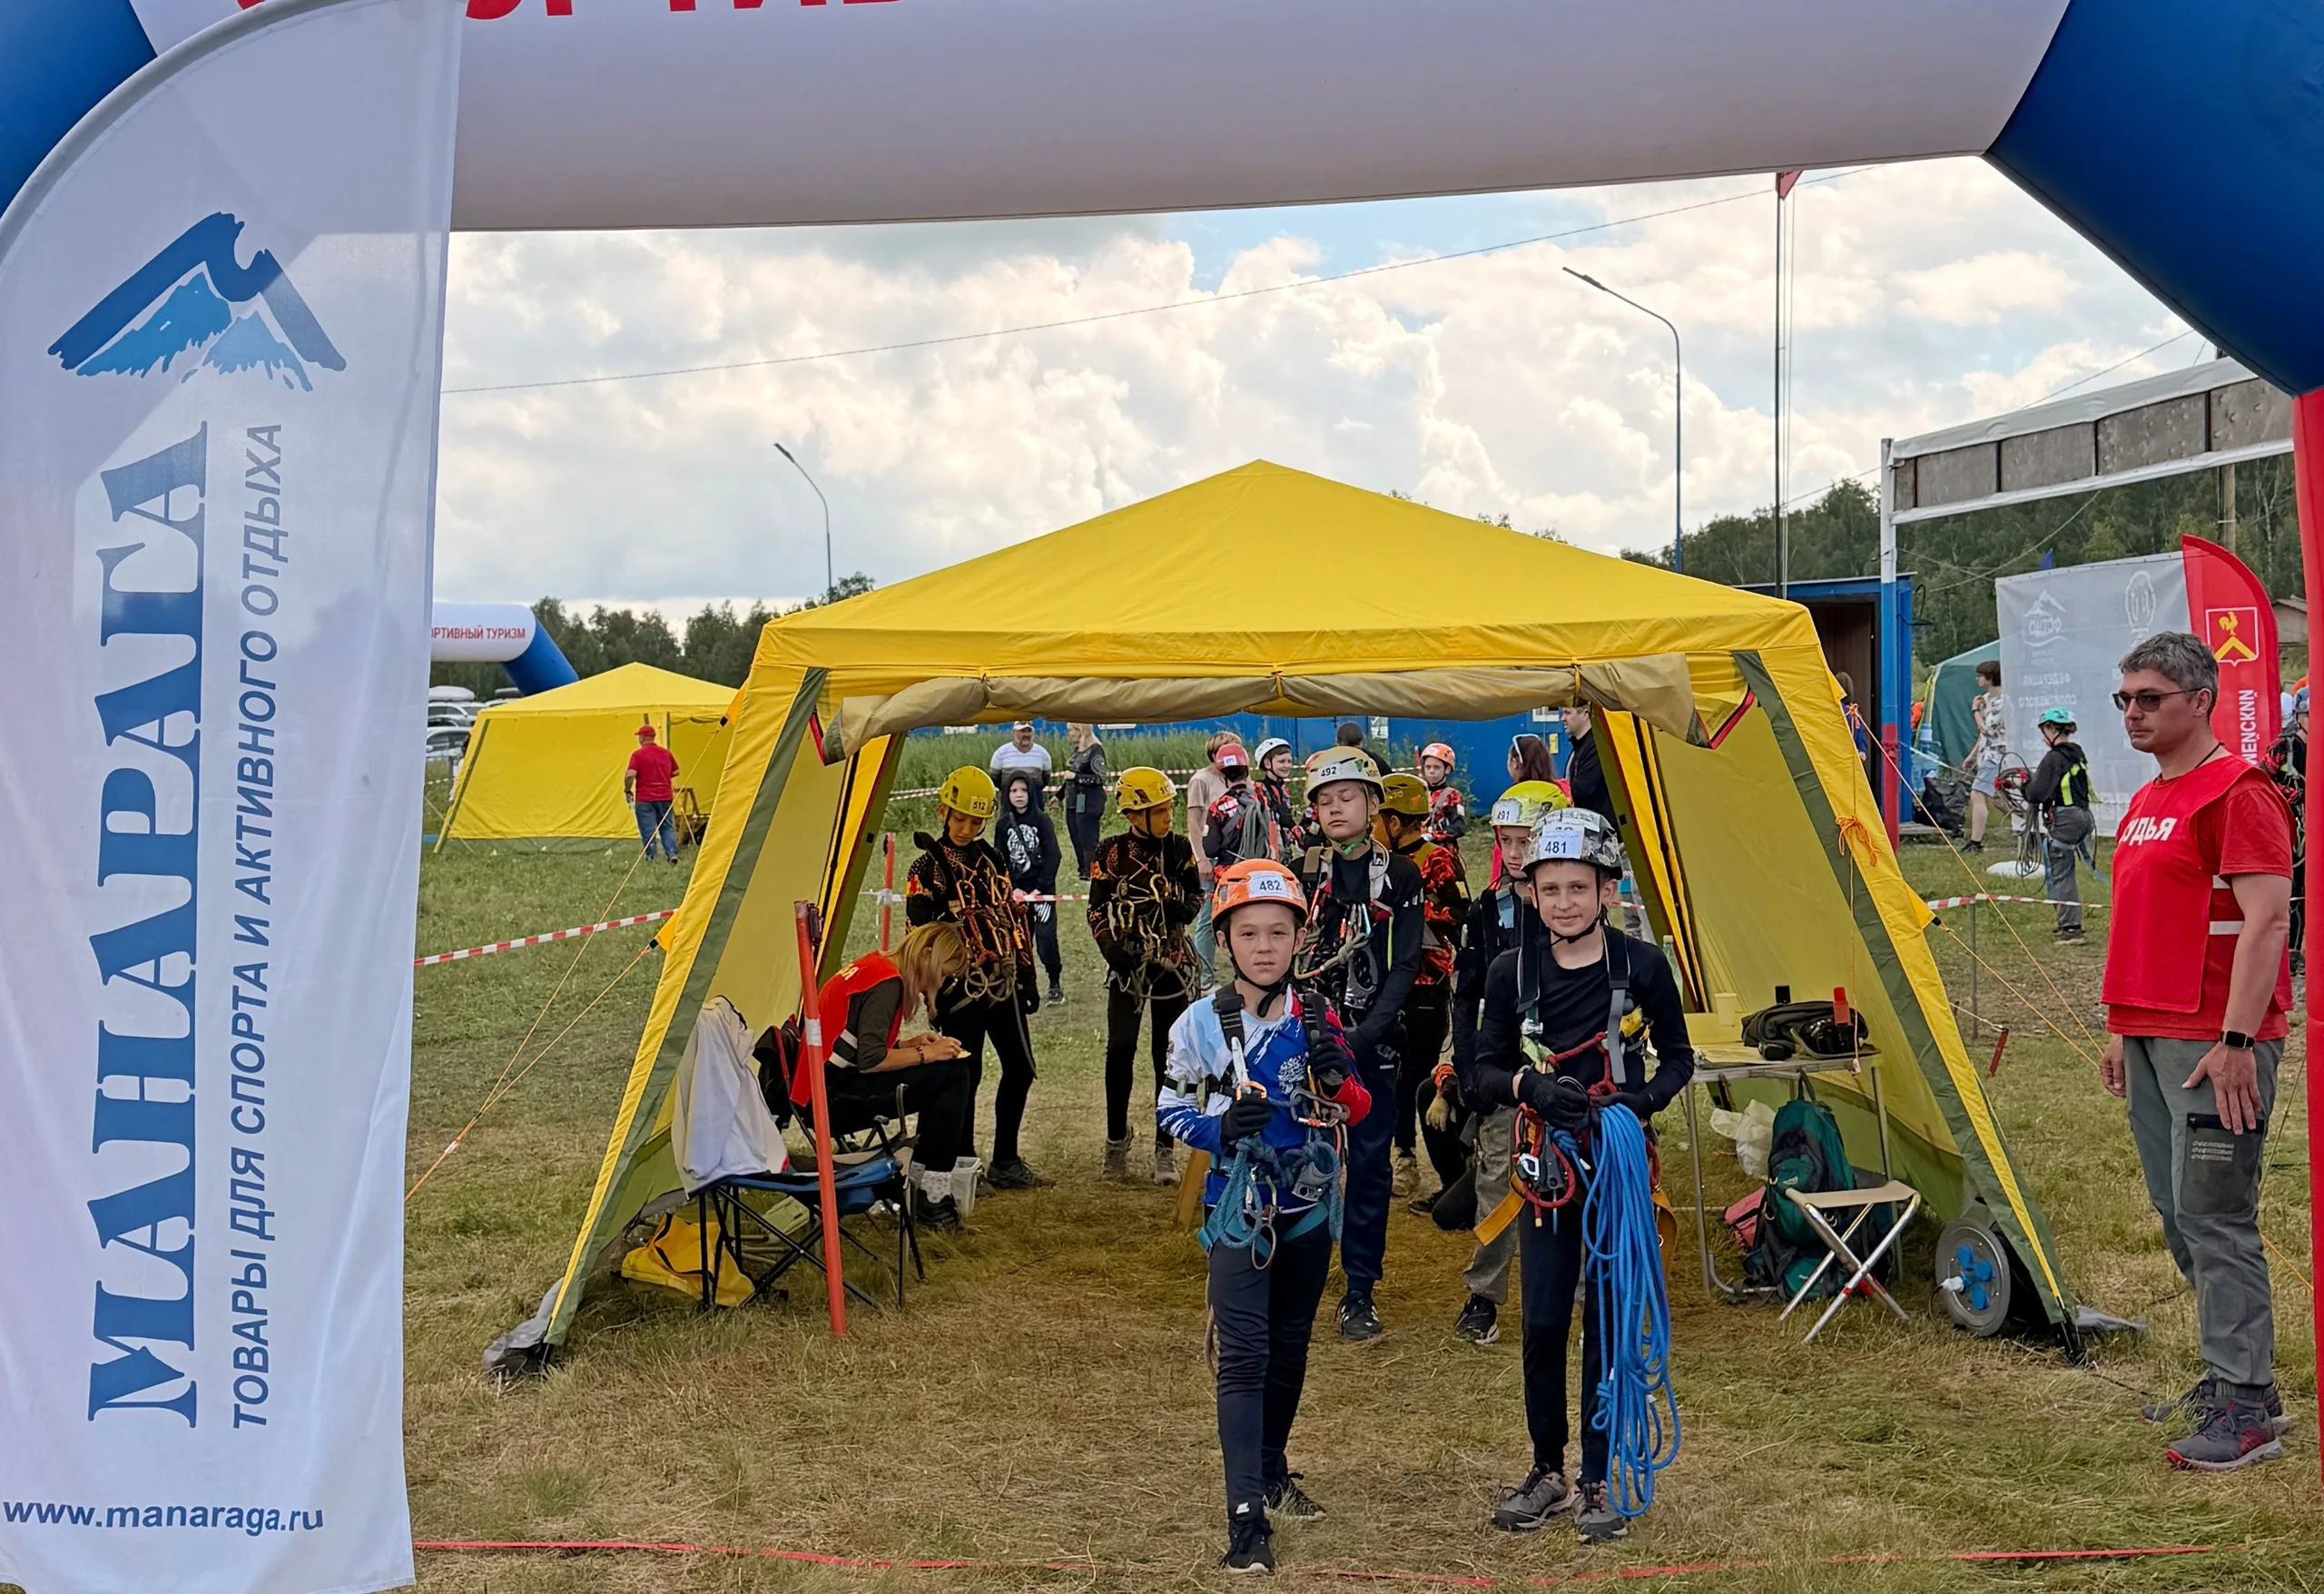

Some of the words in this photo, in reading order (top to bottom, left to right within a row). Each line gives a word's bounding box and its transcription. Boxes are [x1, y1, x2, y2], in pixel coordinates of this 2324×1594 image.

[241, 424, 289, 616] ОТДЫХА
[431, 625, 483, 639] РТИВНЫЙ
[486, 628, 526, 639] ТУРИЗМ
[234, 630, 278, 906] АКТИВНОГО
[1321, 766, 1336, 777] 492
[972, 801, 987, 810] 512
[1545, 841, 1567, 854] 481
[2119, 816, 2178, 847] УДЬЯ
[1259, 880, 1283, 891] 482
[87, 420, 208, 1428] МАНАРАГА
[233, 914, 270, 947] И
[230, 961, 269, 1135] СПОРТА
[230, 1146, 276, 1241] ДЛЯ
[230, 1249, 270, 1429] ТОВАРЫ
[3, 1501, 324, 1537] www.manaraga.ru
